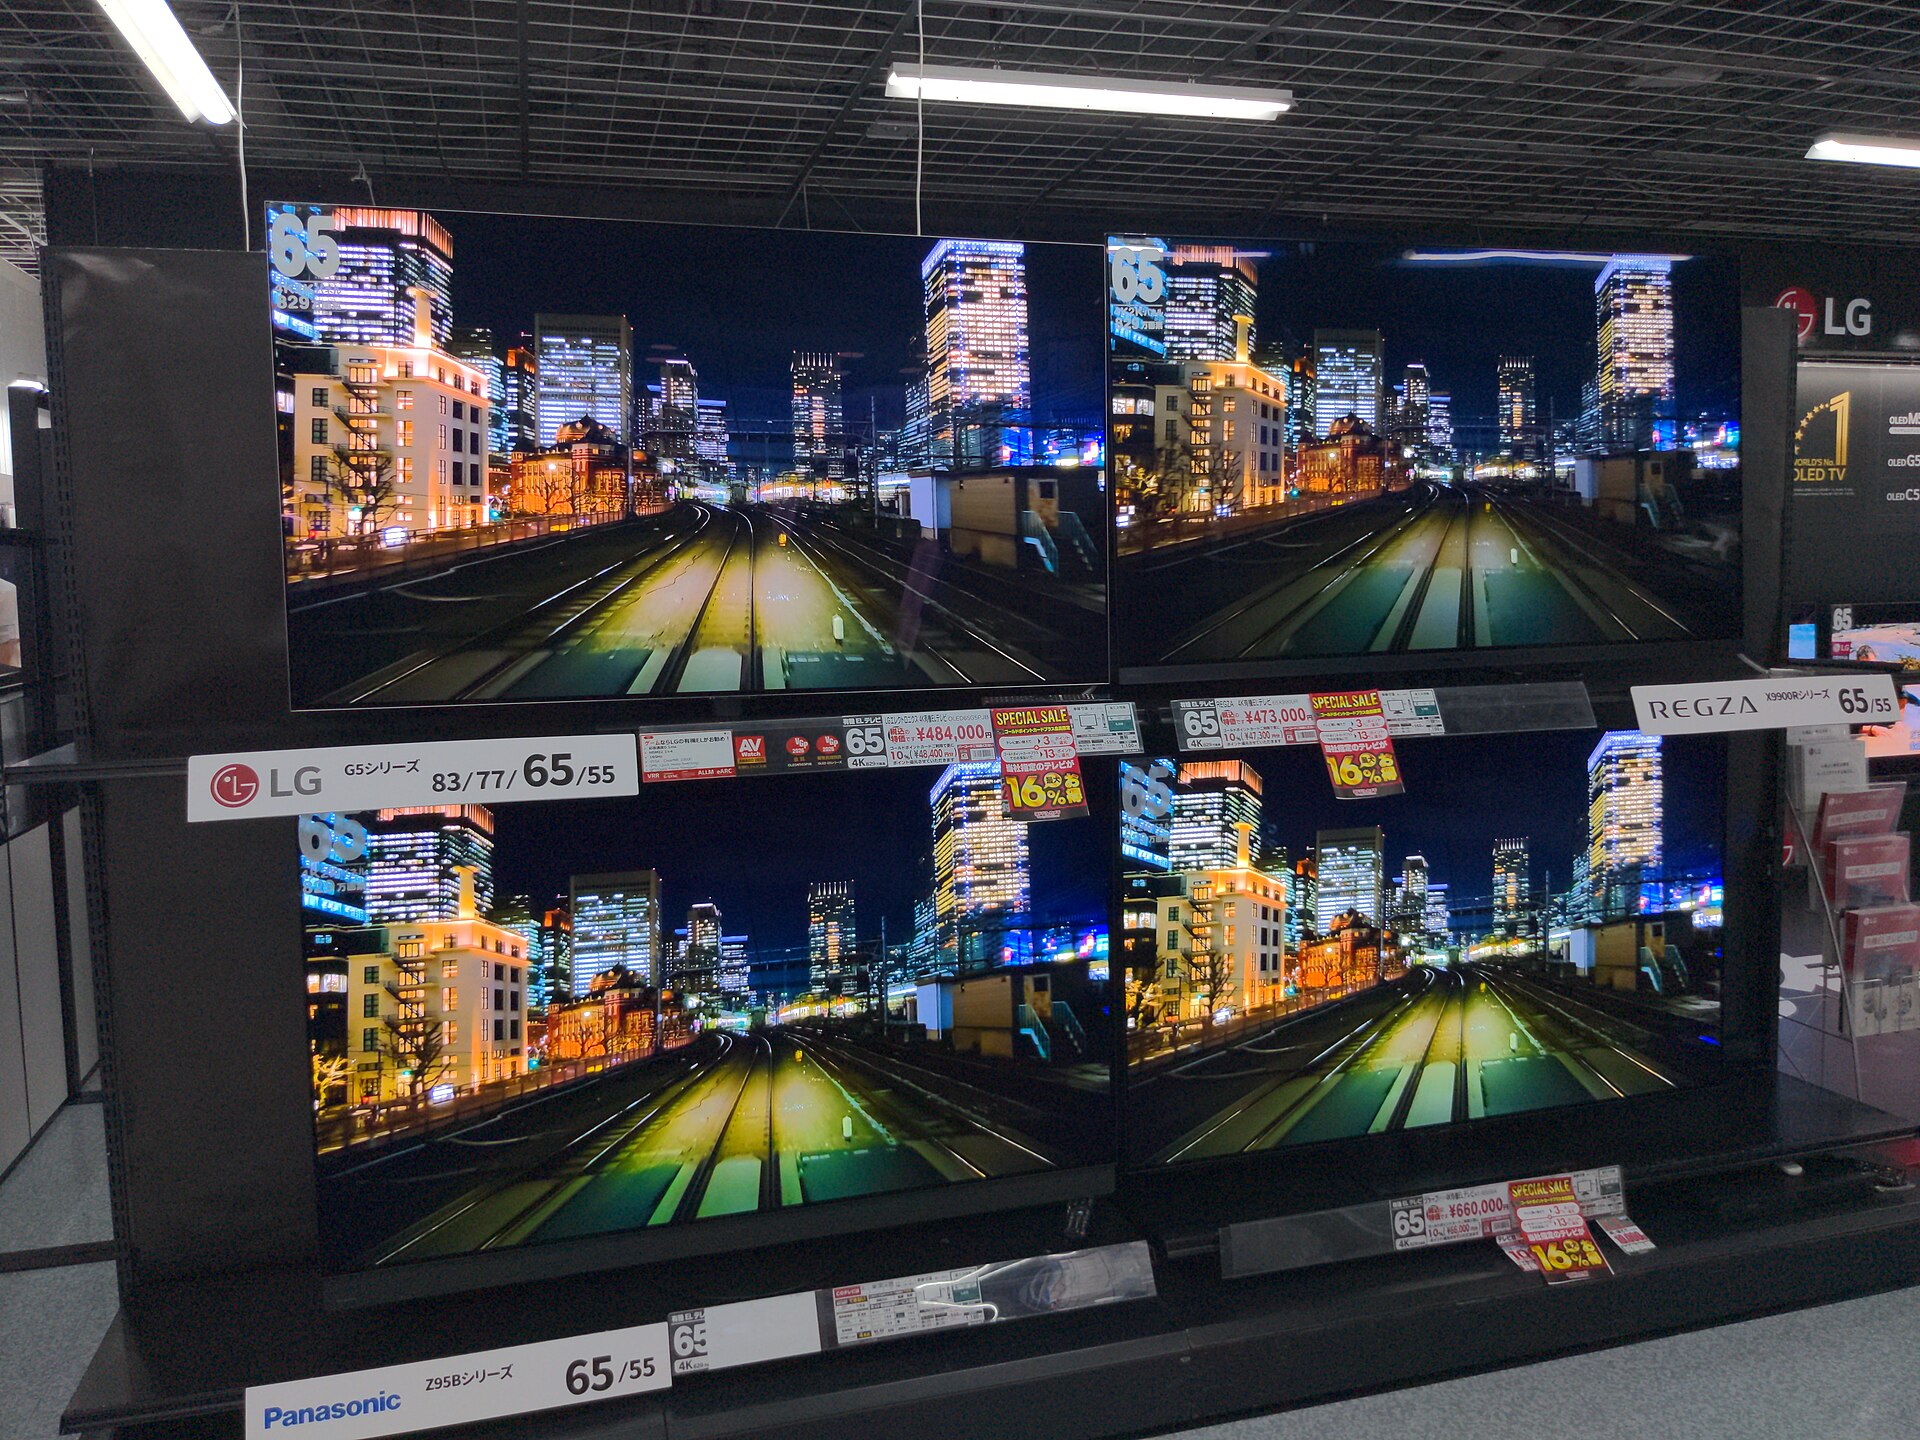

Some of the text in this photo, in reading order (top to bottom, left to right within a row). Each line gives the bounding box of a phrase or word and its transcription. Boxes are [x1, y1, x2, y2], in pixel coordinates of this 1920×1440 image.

[272, 213, 340, 277] 65
[1112, 247, 1163, 303] 65
[1824, 297, 1871, 336] LG
[1828, 468, 1846, 481] TV
[1833, 607, 1852, 630] 65
[1312, 692, 1378, 709] SPECIAL SALE
[1765, 689, 1830, 702] X9900Rシリーズ
[1838, 688, 1892, 714] 65/55
[996, 708, 1067, 726] SPECIAL SALE
[1648, 696, 1758, 719] REGZA
[1184, 711, 1218, 736] 65
[739, 738, 761, 752] AV
[795, 737, 809, 749] VGP
[825, 735, 838, 747] VGP
[846, 727, 884, 754] 65
[344, 758, 420, 776] G5シリーズ
[852, 758, 866, 767] 4K
[270, 766, 322, 798] LG
[1122, 766, 1170, 818] 65
[1511, 1183, 1549, 1198] SPECIAL
[1548, 1179, 1571, 1194] SALE
[1394, 1208, 1425, 1236] 65
[1399, 1239, 1410, 1247] 4K
[674, 1323, 706, 1356] 65
[565, 1355, 656, 1395] 65/55
[679, 1359, 693, 1370] 4K
[425, 1364, 513, 1392] Z95Bシリーズ
[263, 1391, 402, 1430] Panasonic
